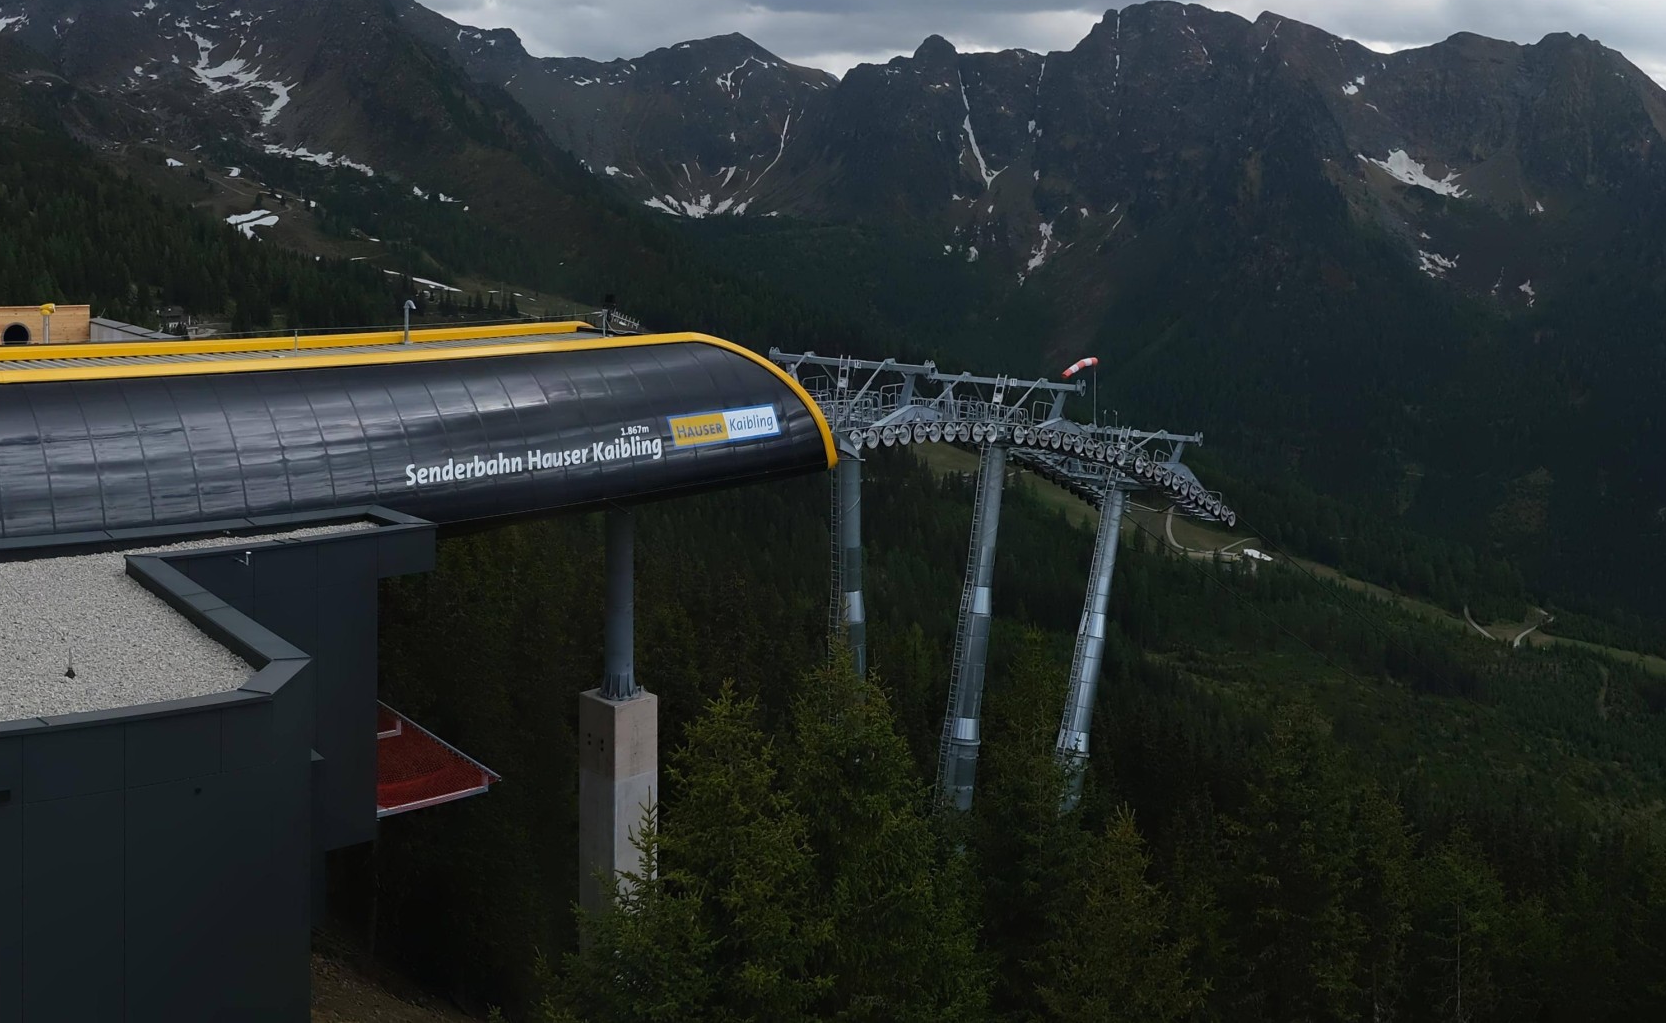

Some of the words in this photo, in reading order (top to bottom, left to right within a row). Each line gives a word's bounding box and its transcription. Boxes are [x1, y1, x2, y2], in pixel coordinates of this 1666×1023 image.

[620, 425, 650, 437] 1.867m
[676, 423, 723, 439] HAUSER
[729, 414, 774, 432] Kaibling
[405, 452, 523, 486] Senderbahn
[527, 448, 589, 471] Hauser
[592, 435, 662, 460] Kaibling
